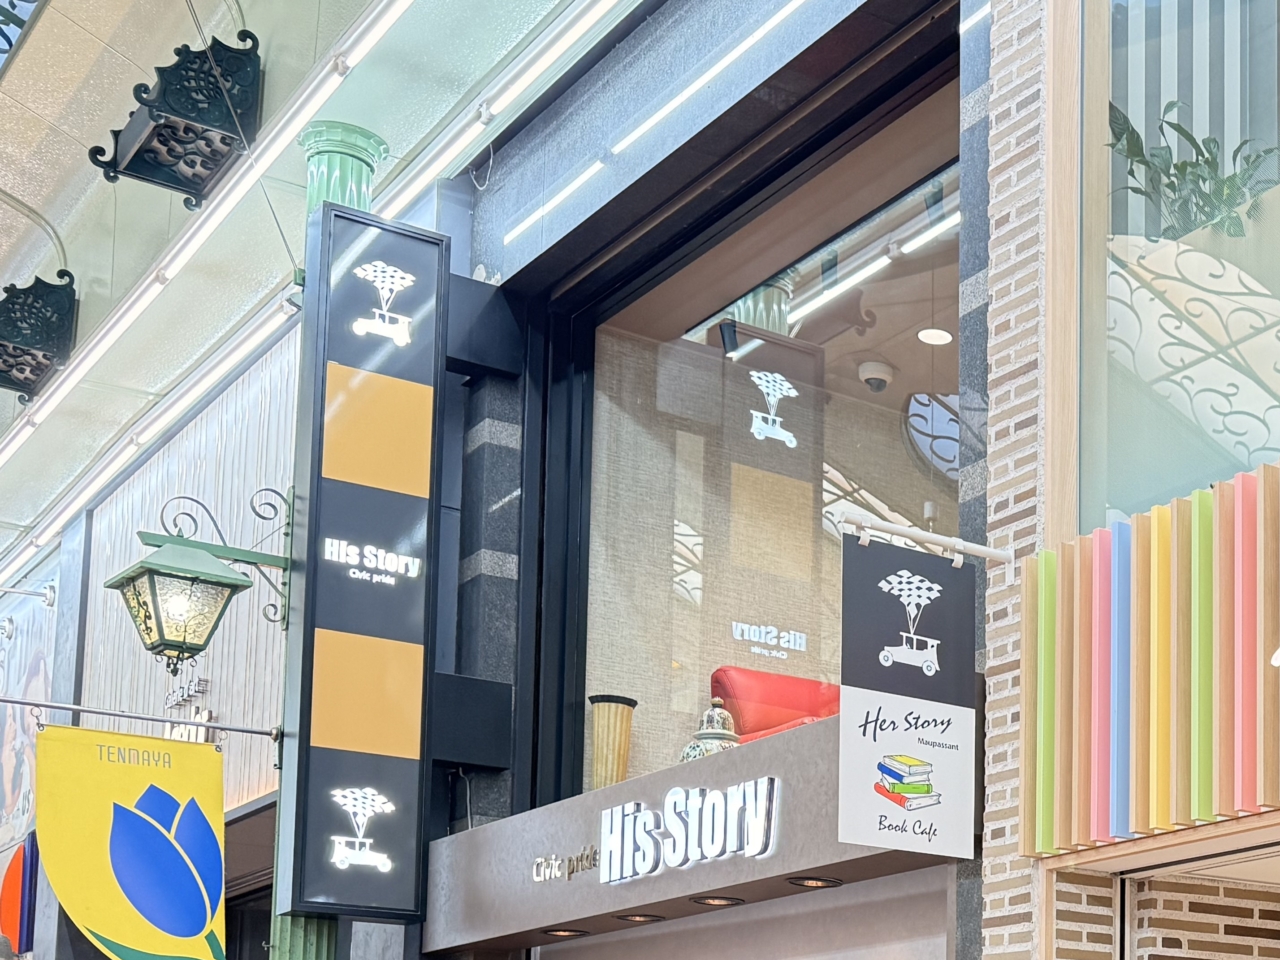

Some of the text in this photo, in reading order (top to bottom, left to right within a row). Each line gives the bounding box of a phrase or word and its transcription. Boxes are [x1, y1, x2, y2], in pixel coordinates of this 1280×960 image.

[324, 538, 421, 577] His Story
[349, 568, 396, 585] Civic pride
[858, 706, 953, 743] Her Story
[917, 736, 960, 752] Maupassant
[600, 776, 781, 885] His Story
[878, 813, 938, 844] Book Cafe
[532, 845, 601, 883] Civic pride
